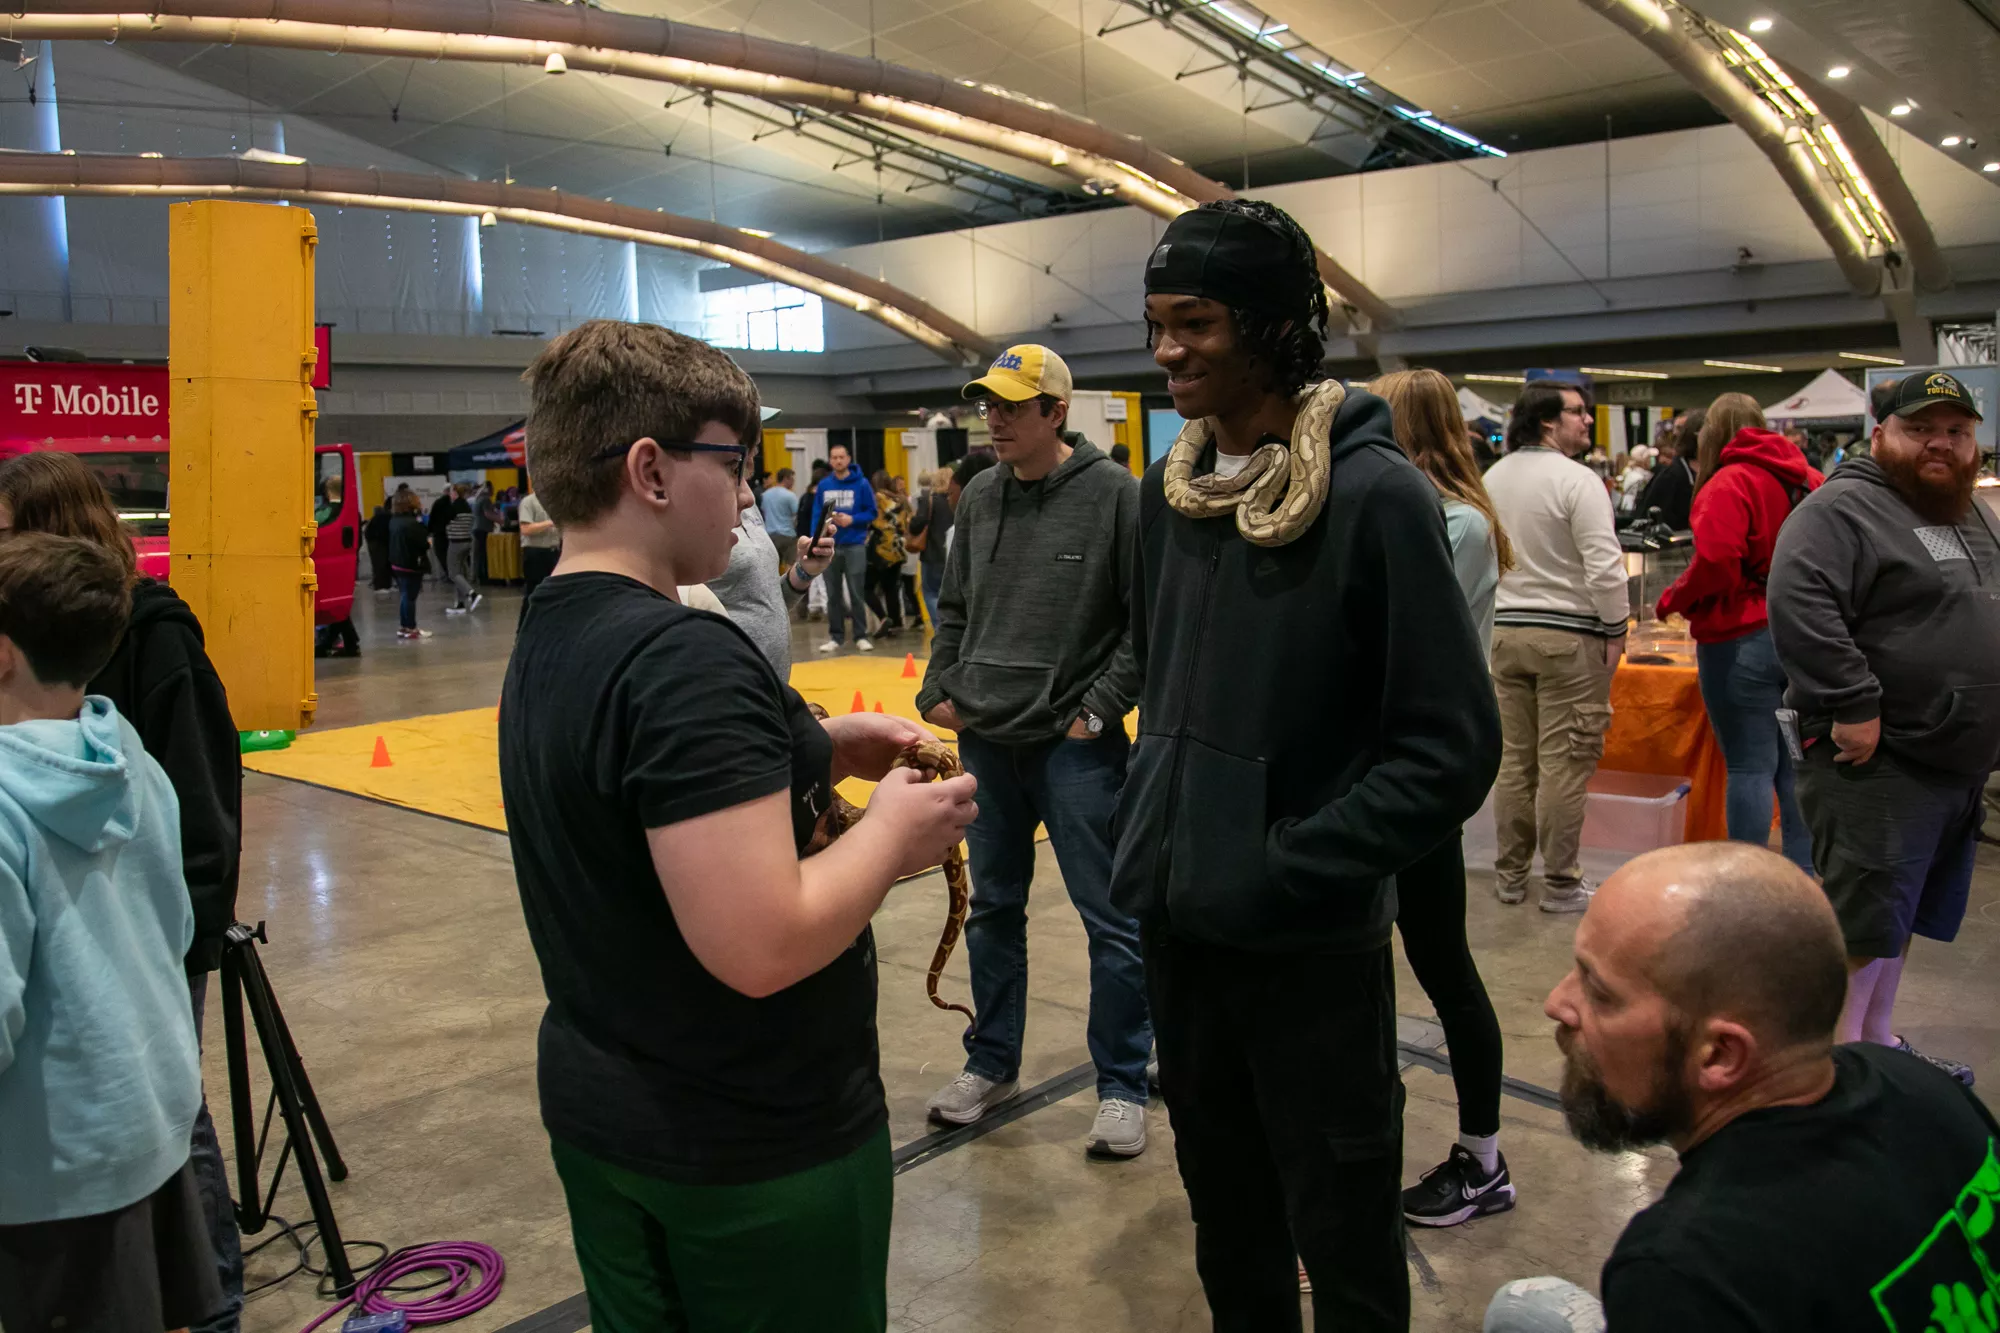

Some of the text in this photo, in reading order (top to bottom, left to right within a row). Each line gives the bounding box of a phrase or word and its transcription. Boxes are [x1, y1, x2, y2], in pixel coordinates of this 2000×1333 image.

[15, 383, 159, 416] T Mobile
[1927, 387, 1960, 397] FOOTBALL
